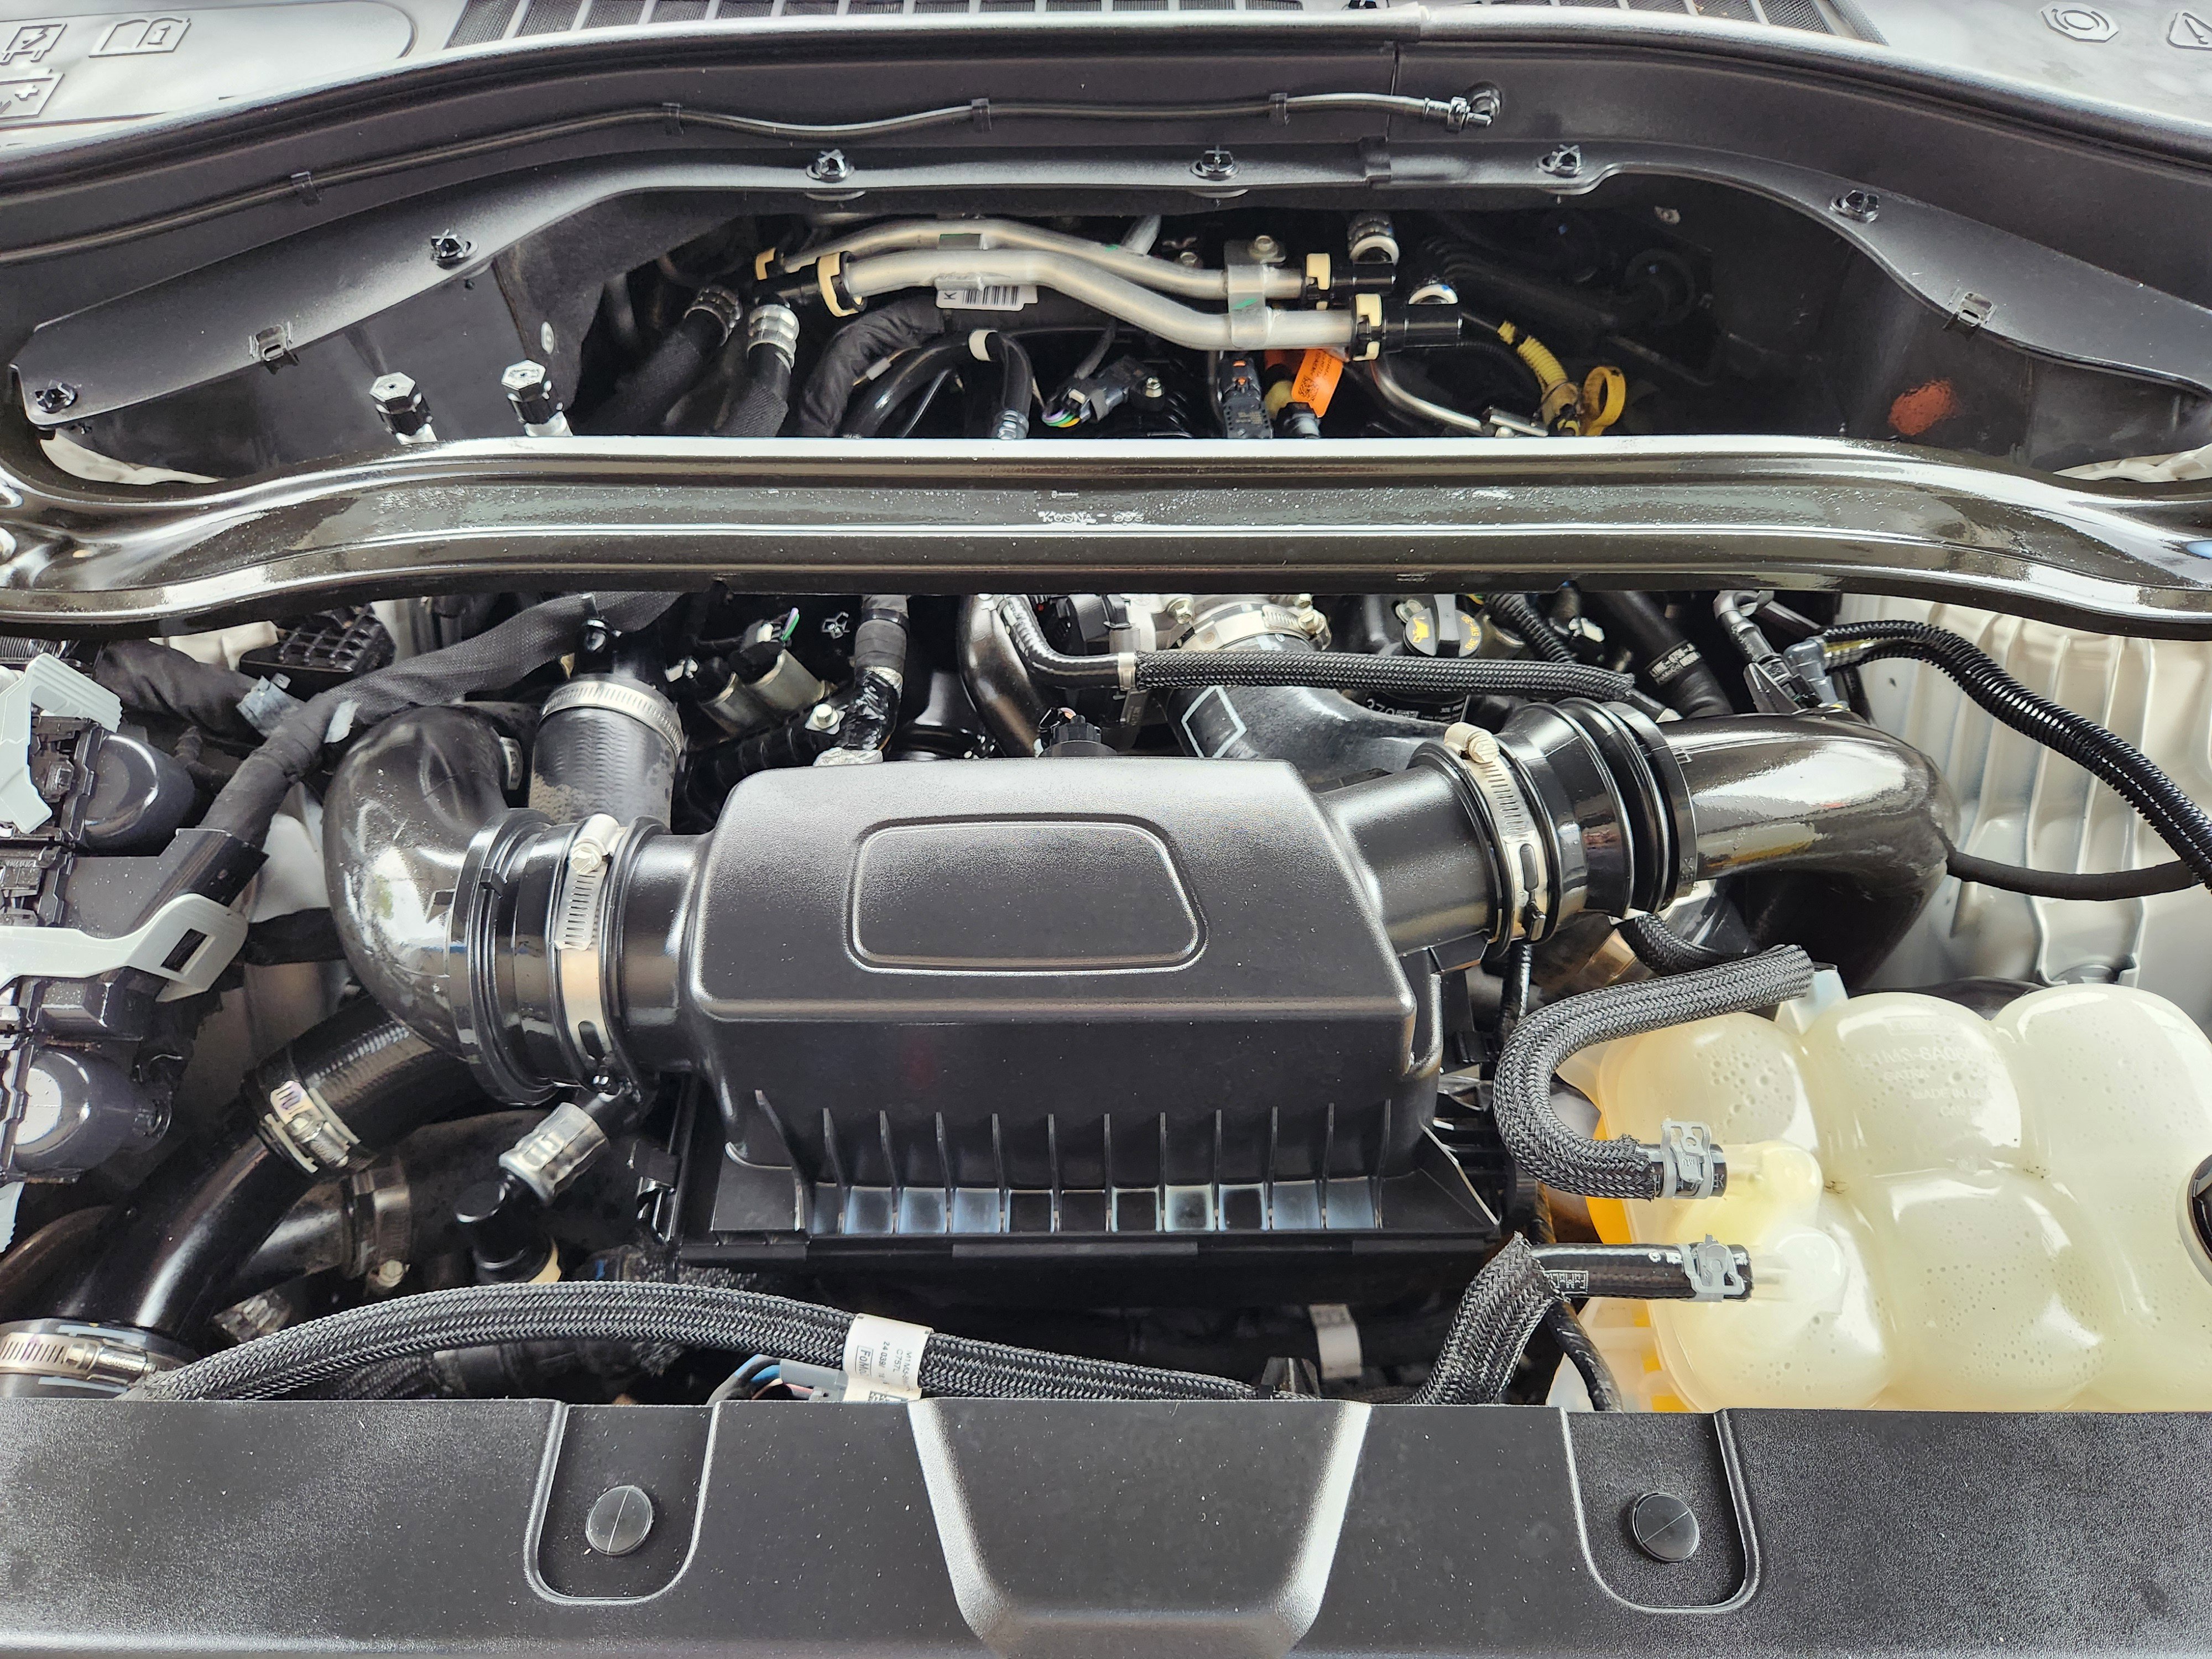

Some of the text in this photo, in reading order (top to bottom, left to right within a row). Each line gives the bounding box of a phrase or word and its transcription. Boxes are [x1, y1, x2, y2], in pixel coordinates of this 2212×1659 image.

[944, 292, 957, 300] K
[1460, 614, 1480, 651] SAE 5W-30
[883, 1341, 890, 1350] 24
